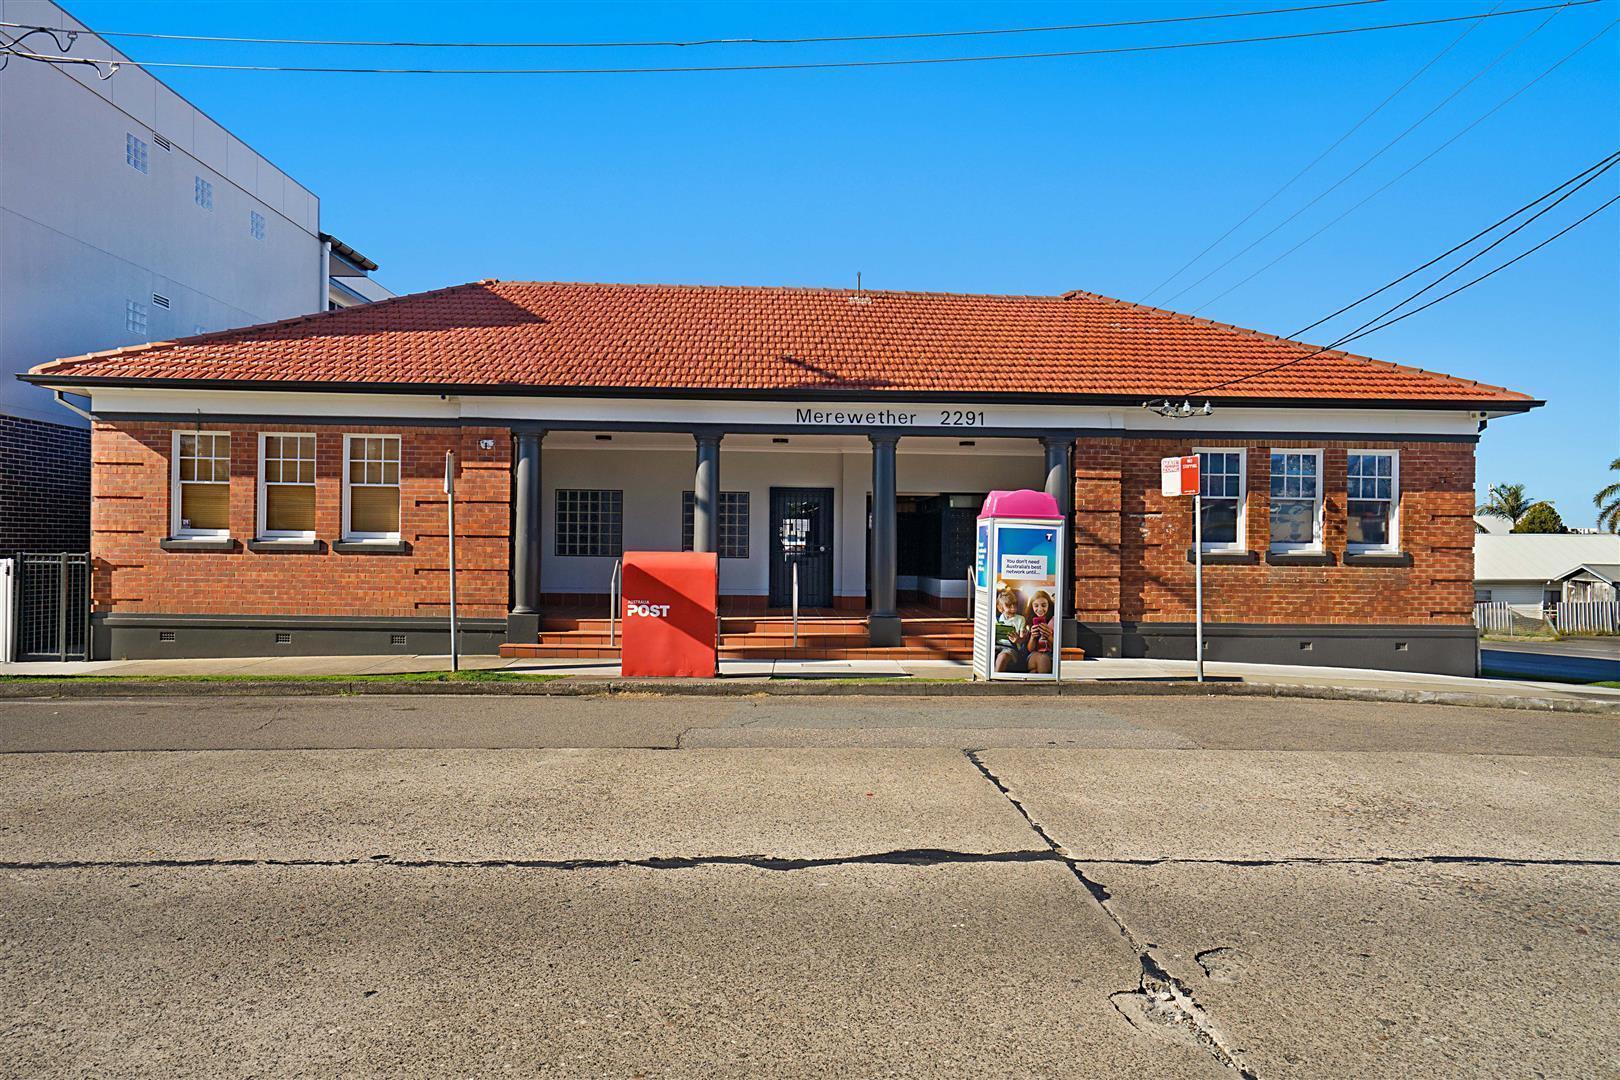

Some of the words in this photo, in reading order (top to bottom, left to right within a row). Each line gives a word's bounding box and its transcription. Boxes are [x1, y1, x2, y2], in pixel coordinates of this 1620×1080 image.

[796, 408, 917, 424] Merewether
[940, 410, 984, 426] 2291
[627, 605, 670, 617] POST
